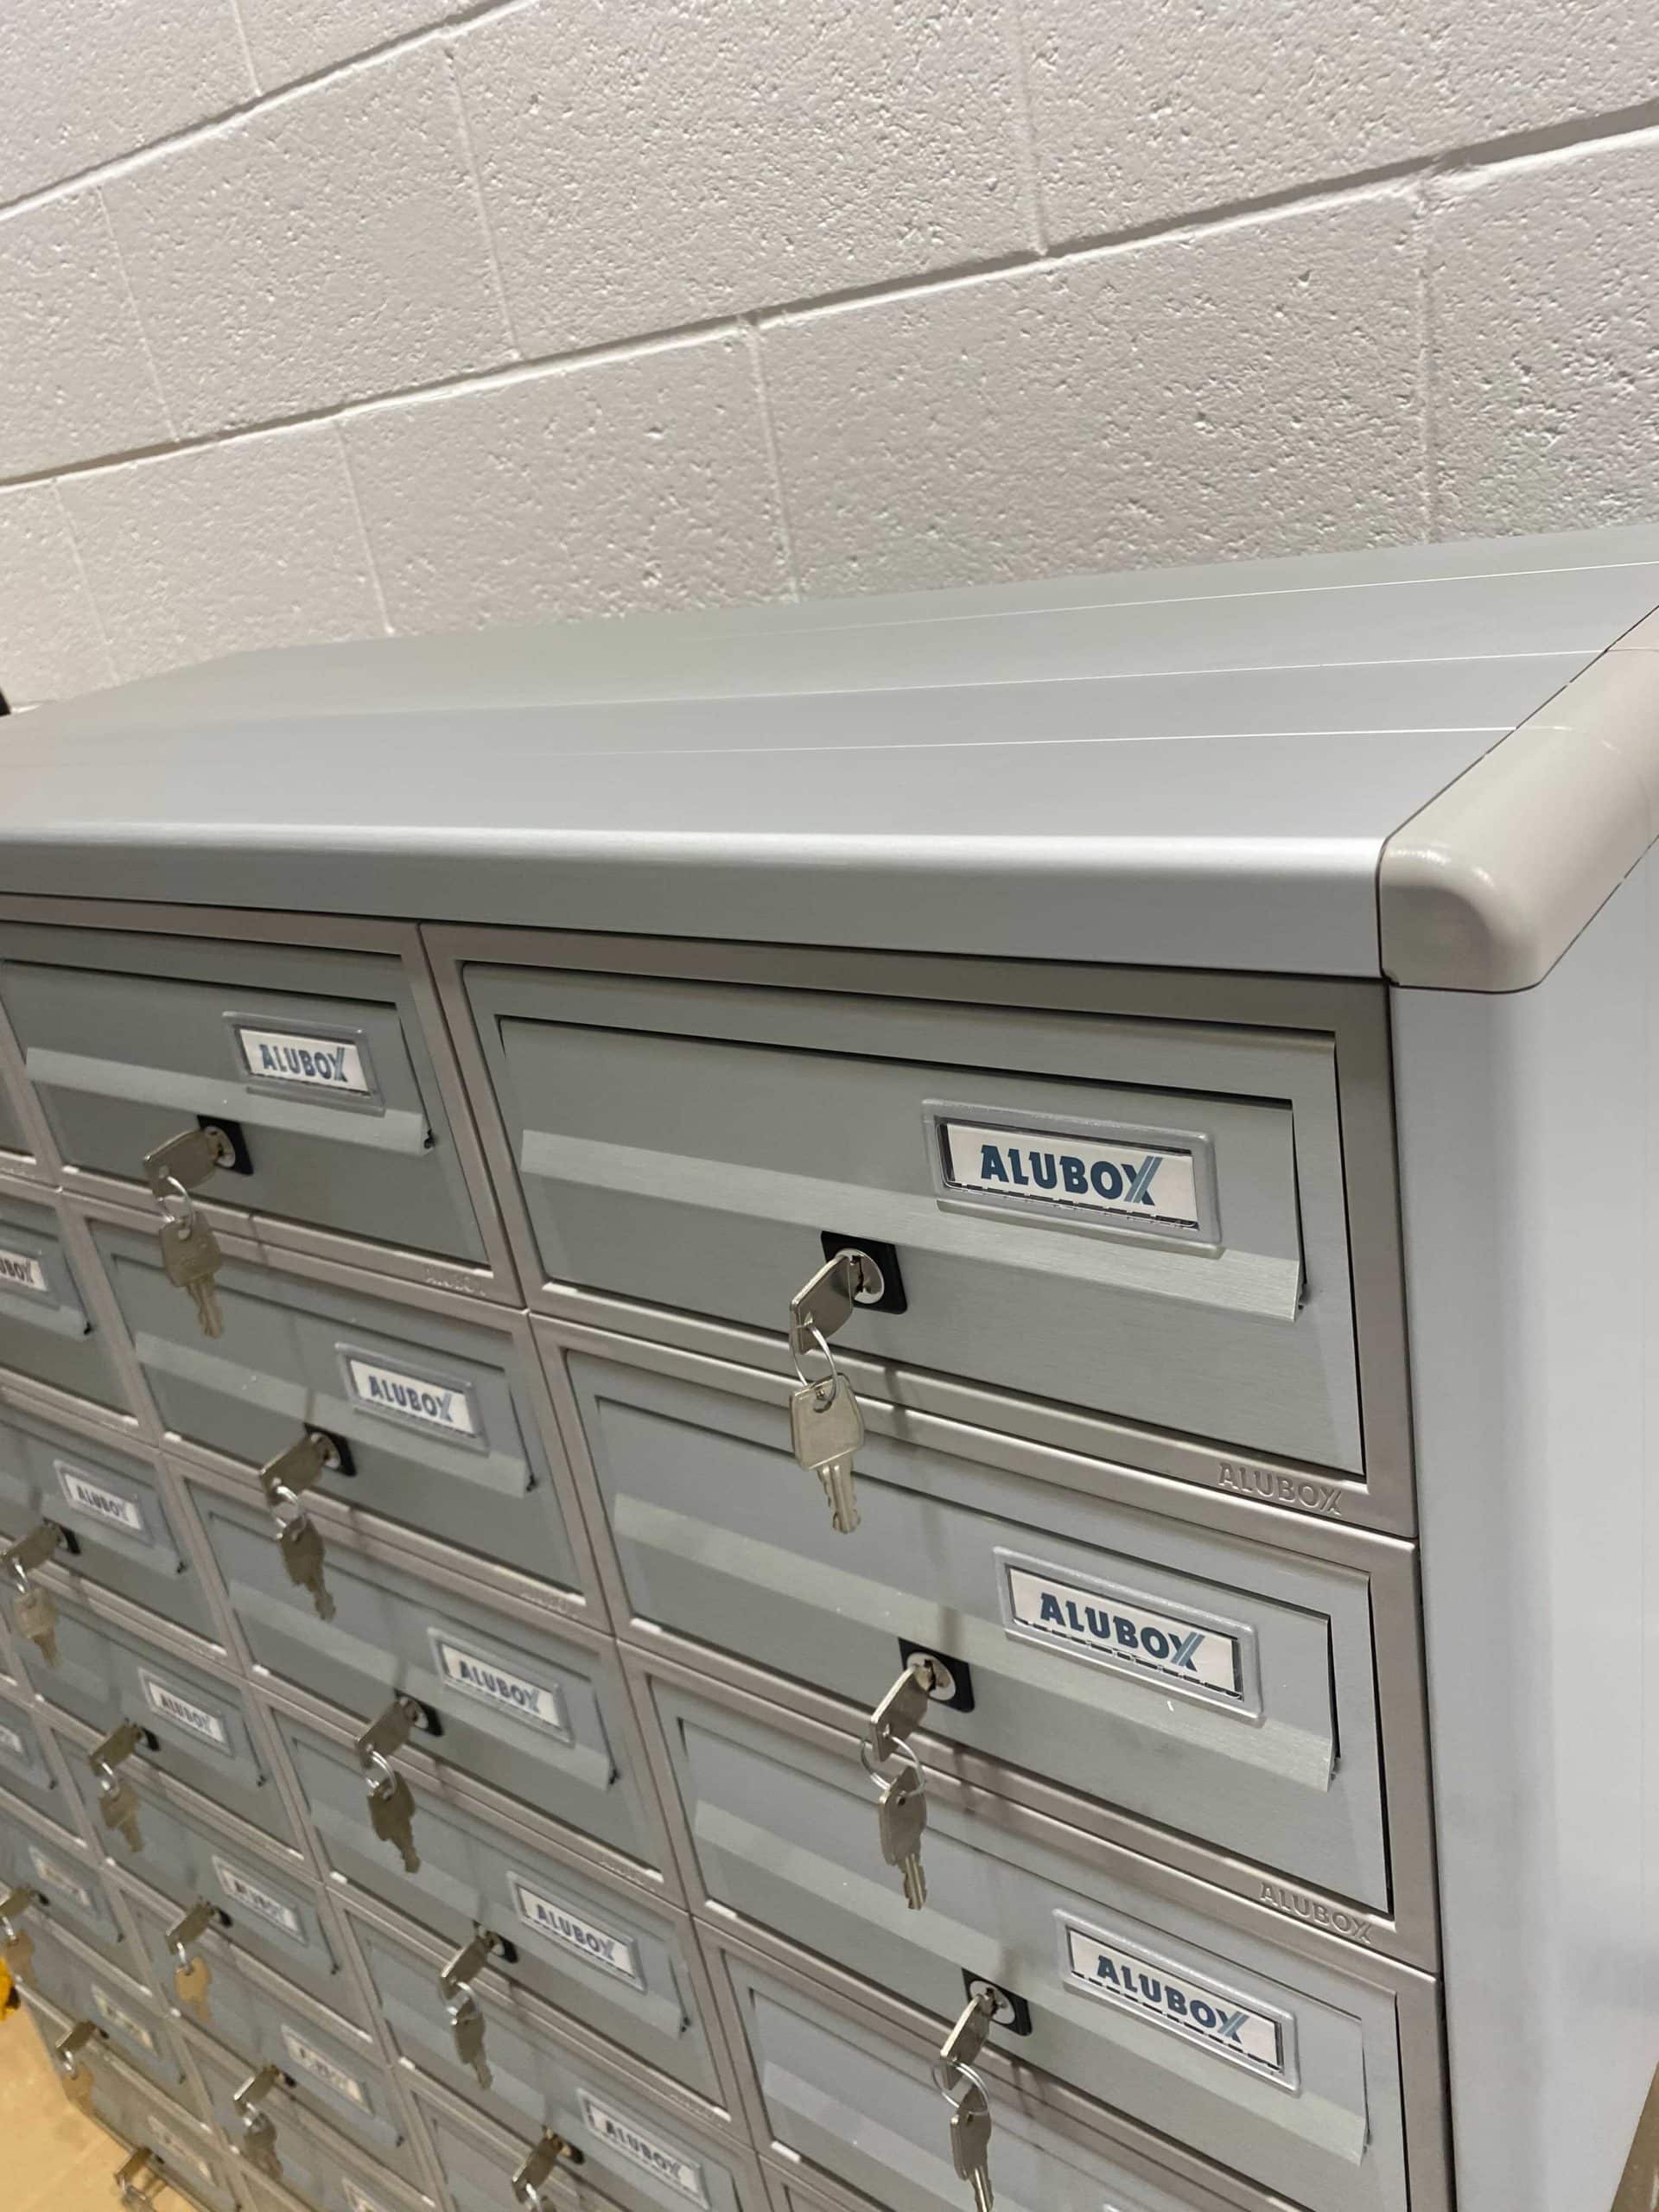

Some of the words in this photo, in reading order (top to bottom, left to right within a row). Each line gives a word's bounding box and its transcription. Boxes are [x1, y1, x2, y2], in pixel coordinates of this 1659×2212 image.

[259, 1043, 348, 1083] ALUBOX
[981, 1144, 1164, 1206] ALUBOX
[367, 1375, 454, 1423] ALUBOX
[1218, 1462, 1343, 1516] ALUBOX
[1039, 1592, 1205, 1671] ALUBOX
[459, 1660, 540, 1713] ALUBOX
[537, 1904, 616, 1961] ALUBOX
[1259, 1882, 1372, 1944] ALUBOX
[1096, 1955, 1250, 2043] ALUBOX
